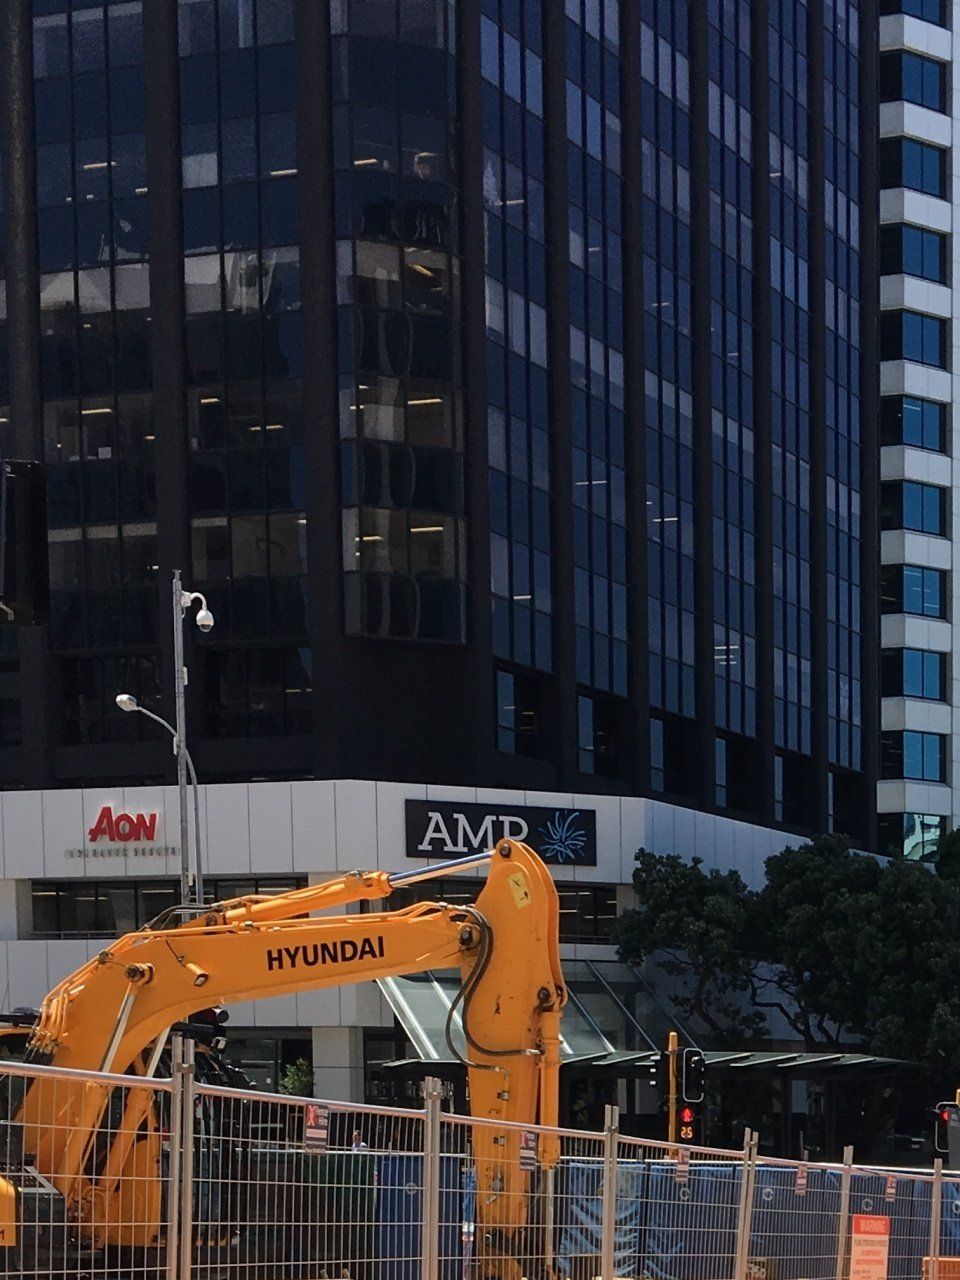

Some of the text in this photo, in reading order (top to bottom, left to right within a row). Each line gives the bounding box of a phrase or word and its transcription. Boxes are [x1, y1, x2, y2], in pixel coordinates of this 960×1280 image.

[417, 811, 529, 853] AMP
[266, 935, 385, 971] HYUNDAI
[859, 1219, 887, 1234] WARNING
